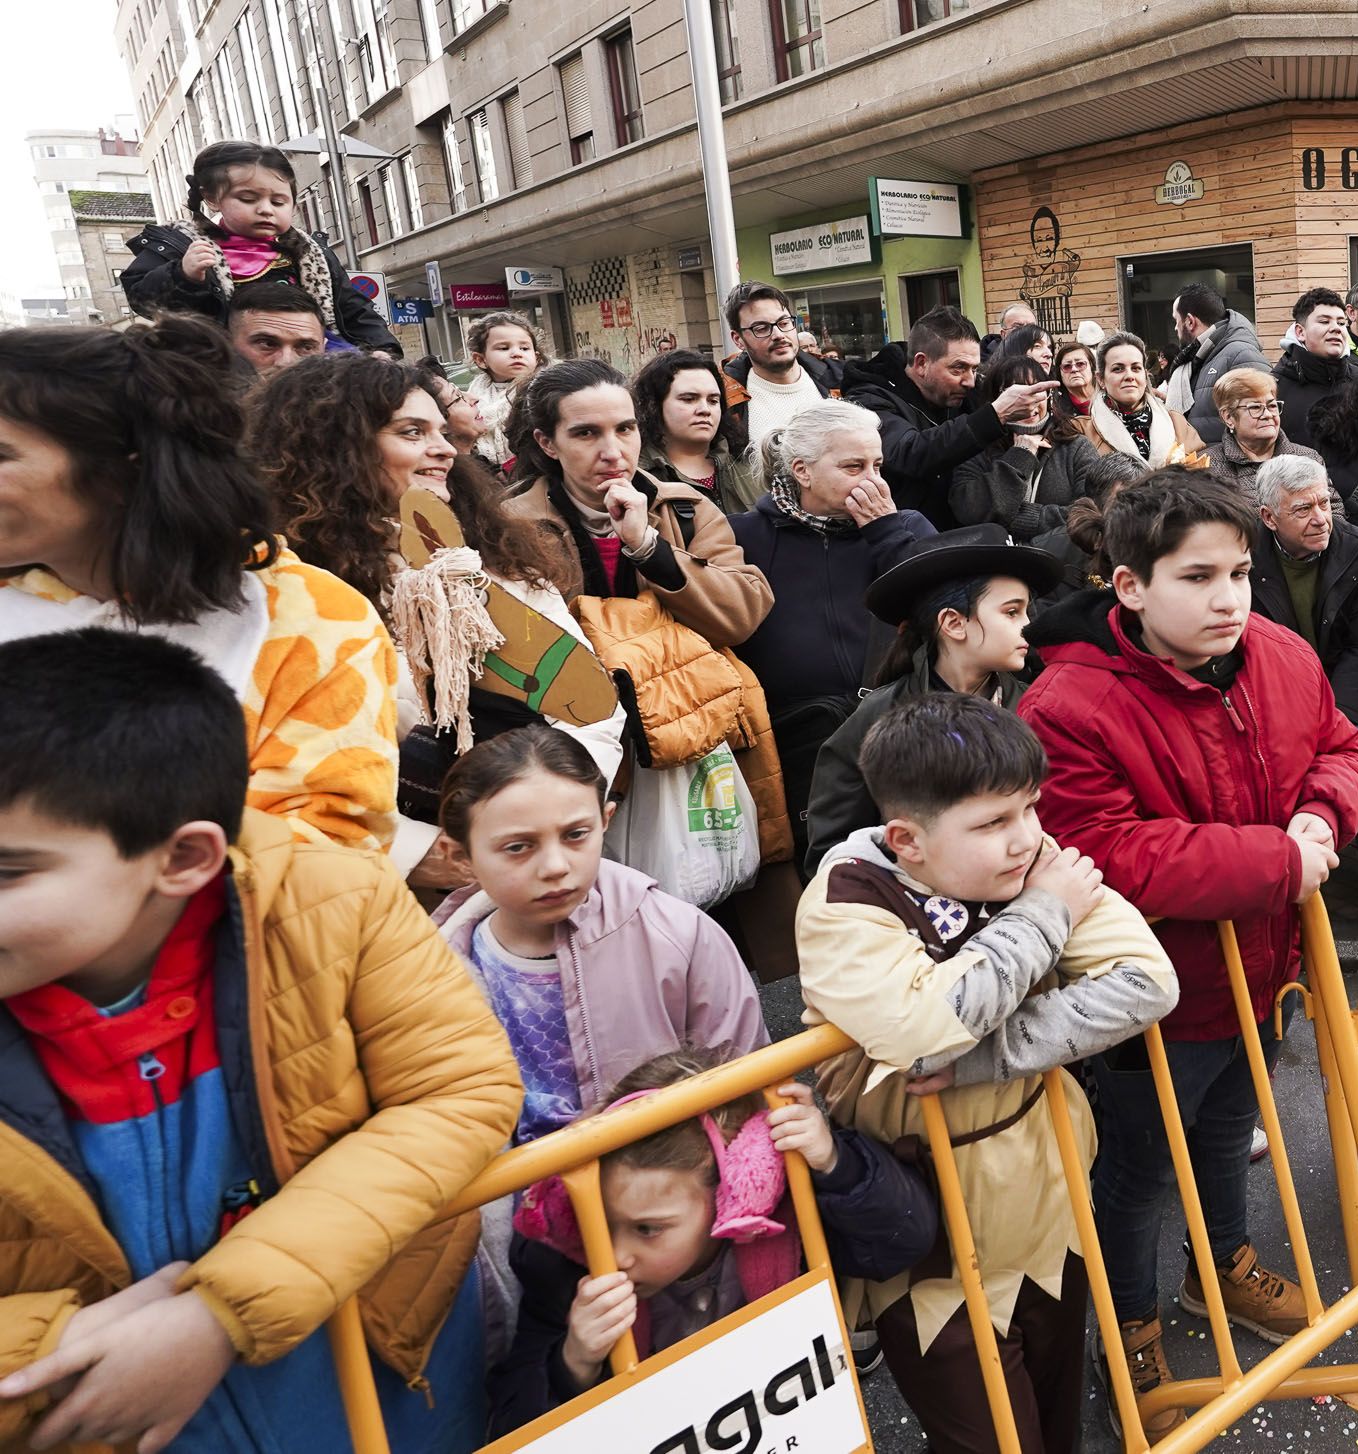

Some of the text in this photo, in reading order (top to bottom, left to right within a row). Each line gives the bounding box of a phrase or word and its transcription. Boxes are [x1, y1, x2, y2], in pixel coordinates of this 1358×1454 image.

[1302, 146, 1326, 190] O
[880, 191, 957, 202] HERBOLARIO ECO NATURAL
[1163, 184, 1196, 198] HERBOGAL
[774, 239, 813, 256] HERBOLARIO
[818, 235, 833, 250] ECO
[832, 228, 865, 245] NATURAL
[397, 315, 419, 323] ATM
[994, 929, 1019, 945] adidas
[1121, 970, 1147, 990] adidas
[1019, 1019, 1034, 1045] adidas
